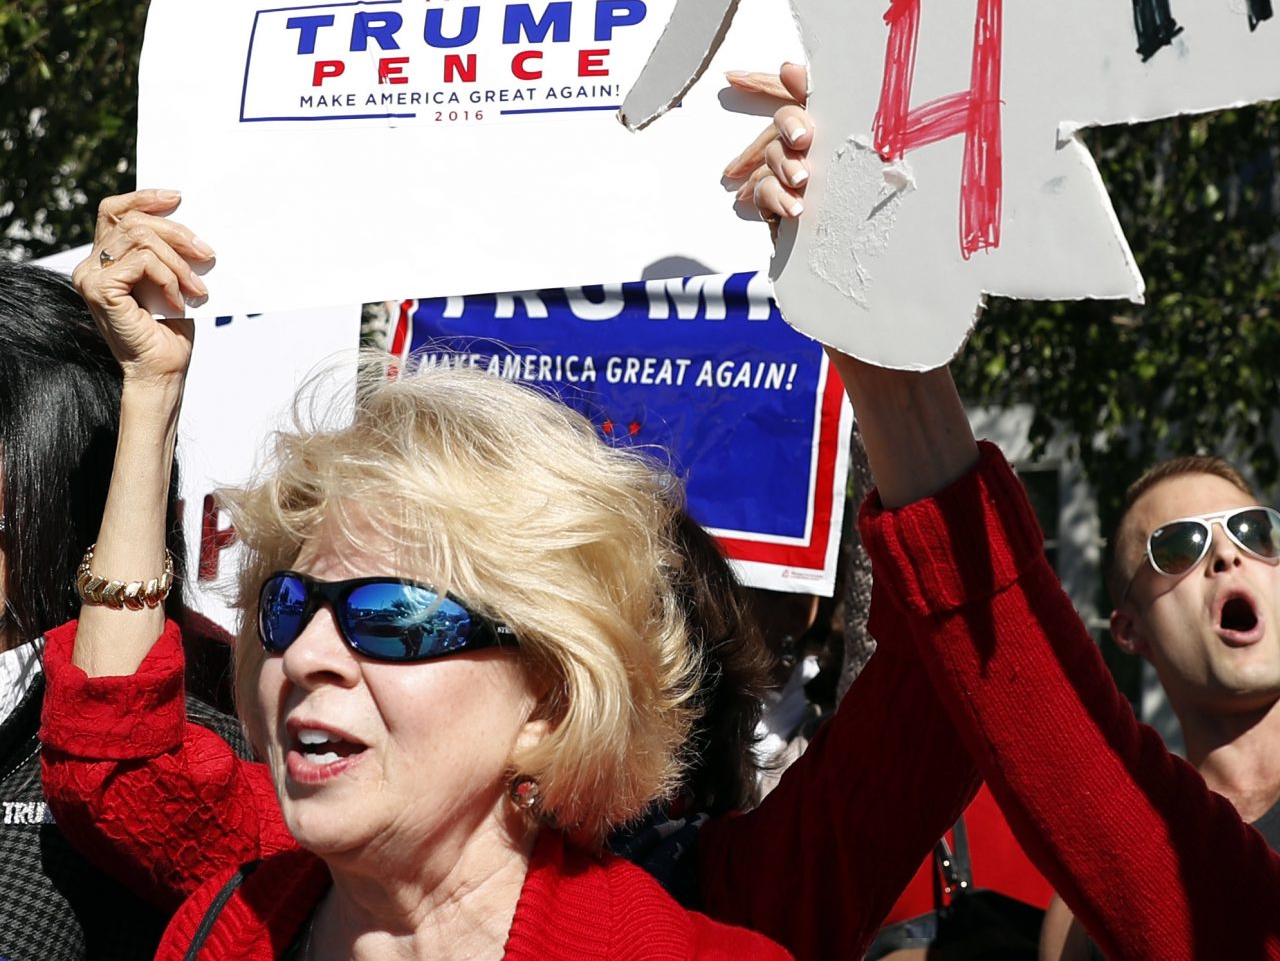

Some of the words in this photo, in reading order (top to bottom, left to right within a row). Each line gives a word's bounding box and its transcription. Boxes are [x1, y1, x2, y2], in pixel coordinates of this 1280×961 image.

[312, 49, 610, 87] PENCE
[299, 94, 356, 108] MAKE
[366, 91, 460, 106] AMERICA
[469, 89, 535, 103] GREAT
[546, 84, 620, 99] AGAIN!
[435, 110, 484, 122] 2016
[487, 354, 597, 383] AMERICA
[606, 356, 690, 386] GREAT
[696, 360, 798, 390] AGAIN!
